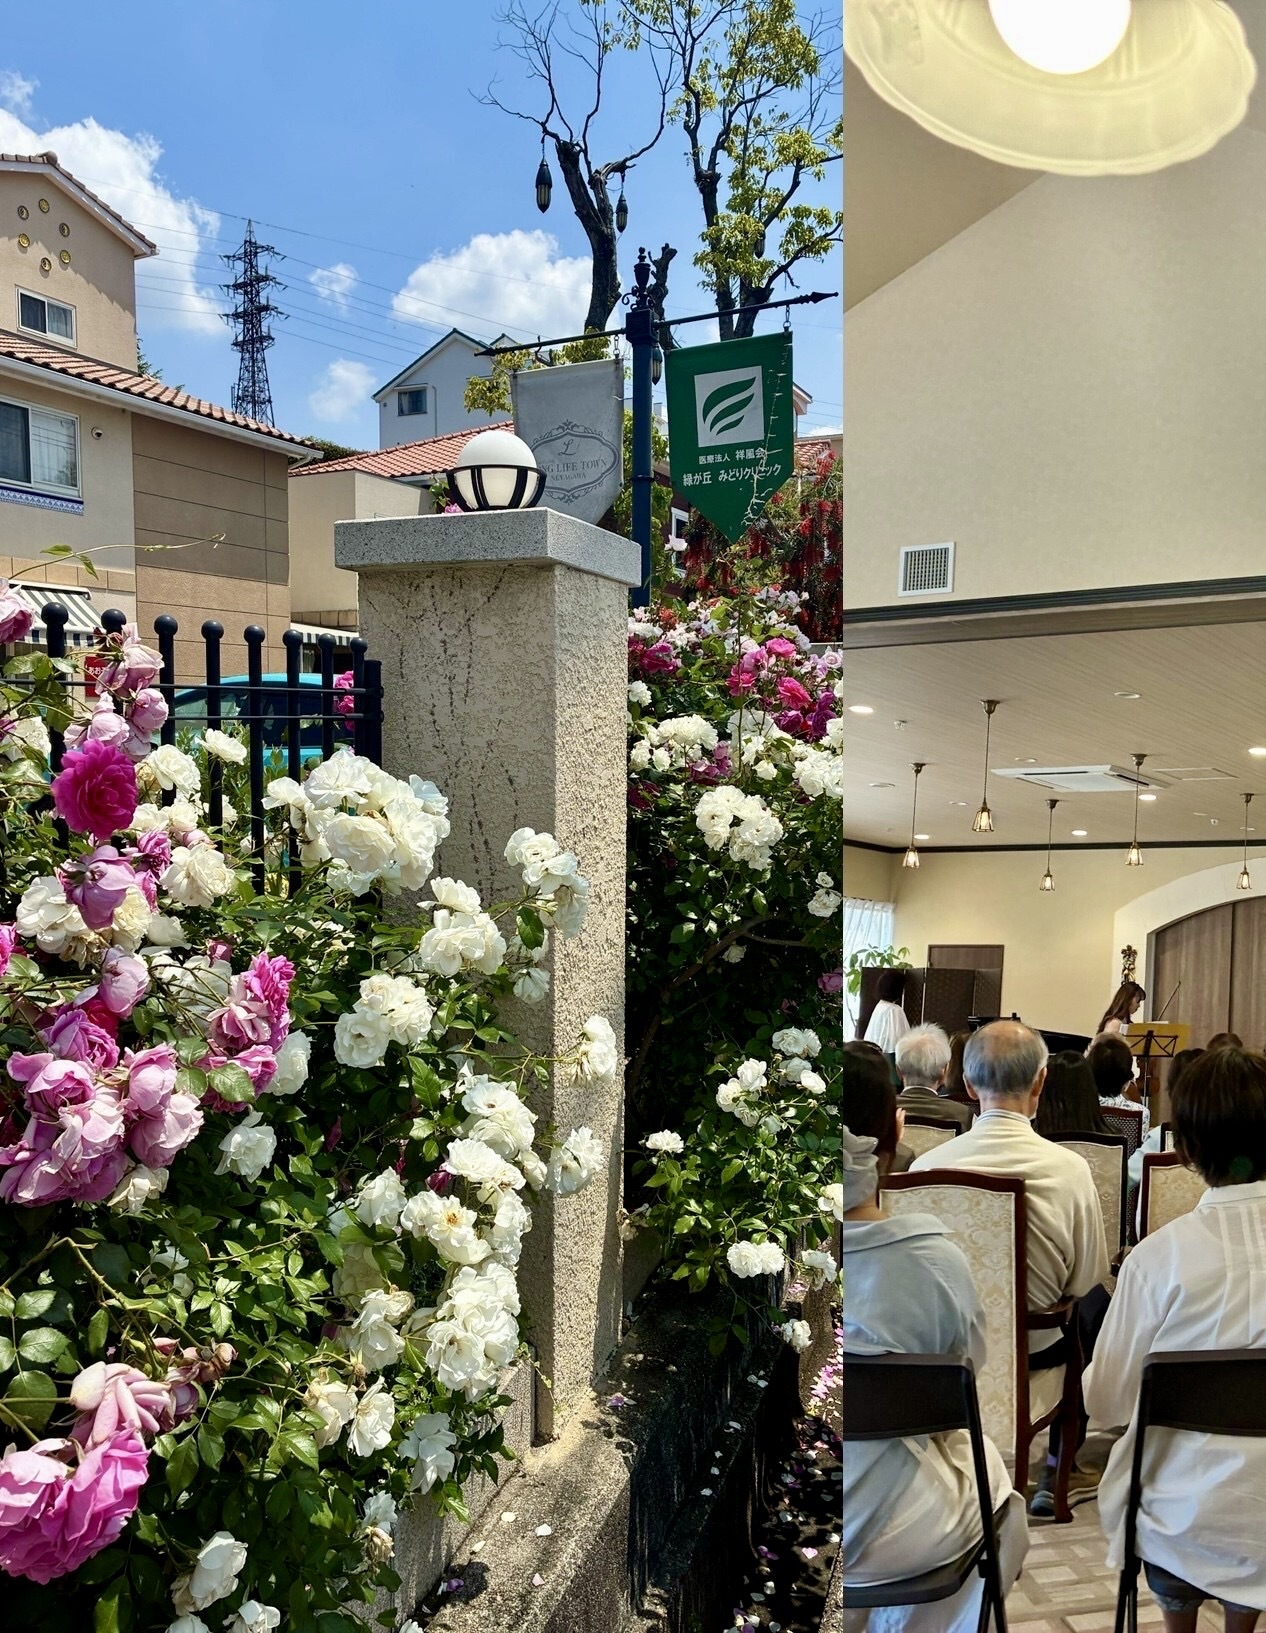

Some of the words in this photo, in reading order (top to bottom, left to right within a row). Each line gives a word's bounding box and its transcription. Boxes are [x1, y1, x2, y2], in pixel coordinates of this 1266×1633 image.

[699, 453, 730, 465] 医療法人
[556, 462, 578, 473] LIFE
[682, 471, 712, 487] 緑が丘
[718, 463, 781, 482] みどりクリニック
